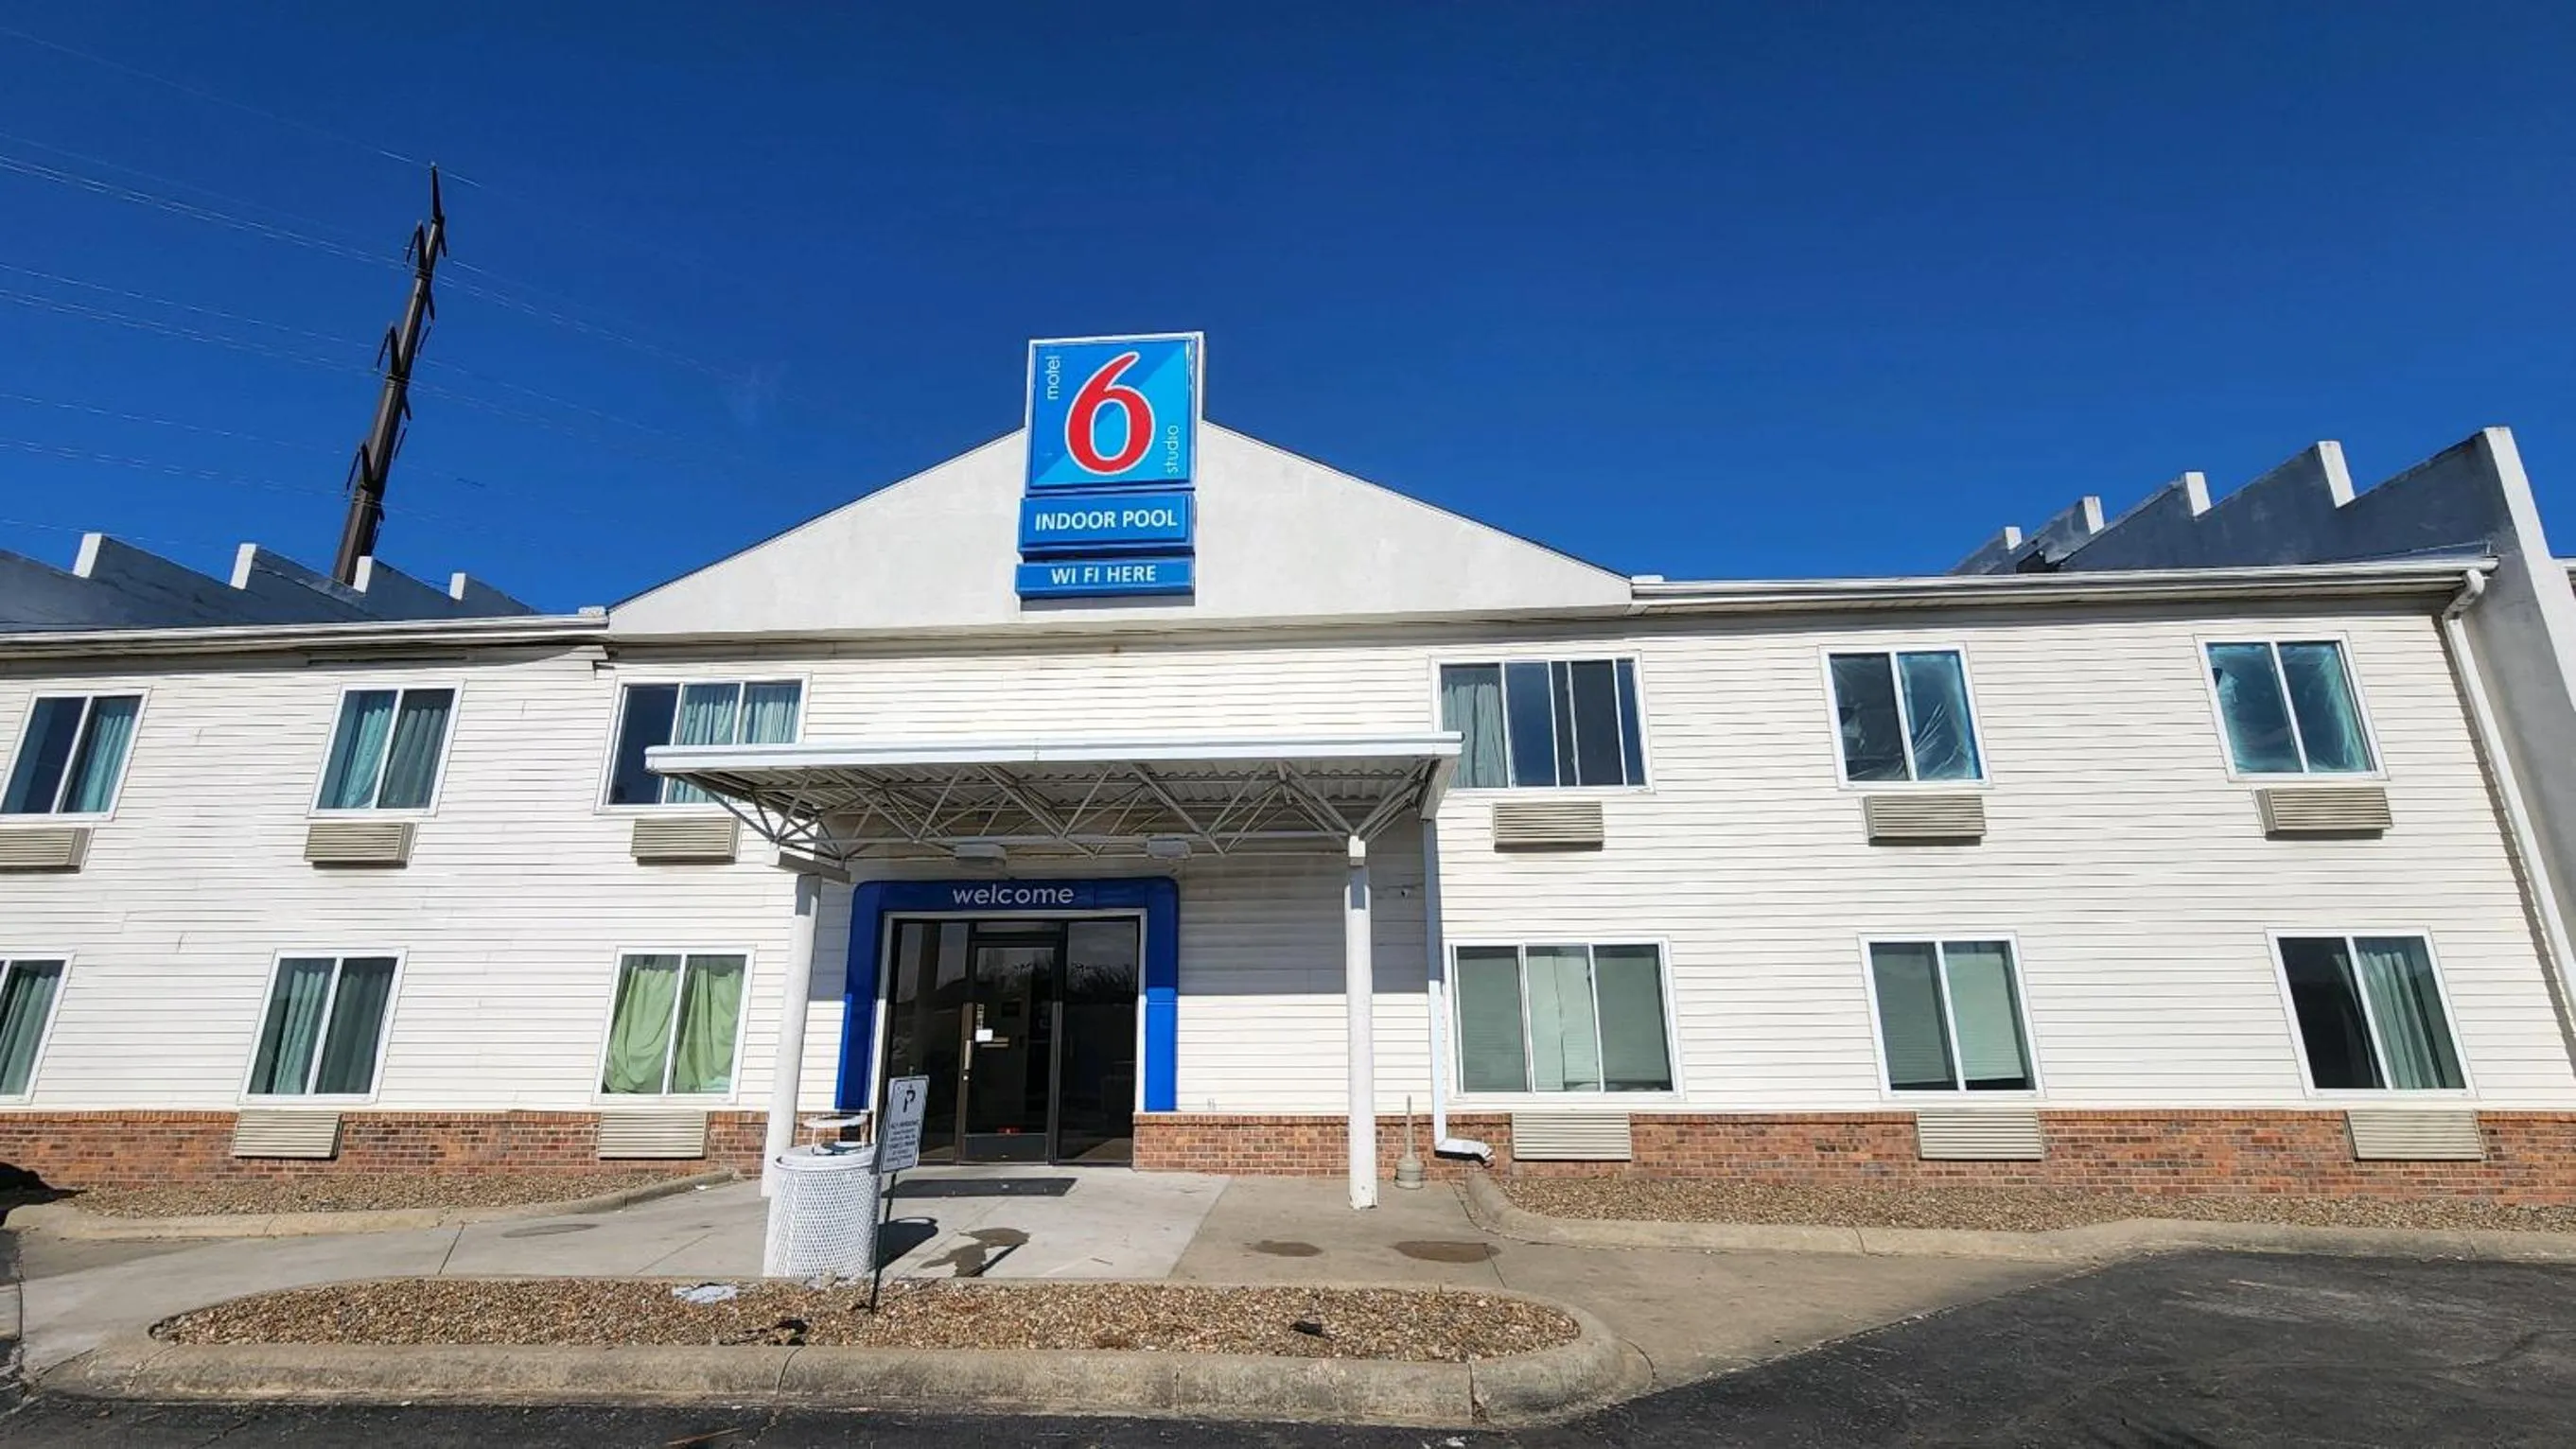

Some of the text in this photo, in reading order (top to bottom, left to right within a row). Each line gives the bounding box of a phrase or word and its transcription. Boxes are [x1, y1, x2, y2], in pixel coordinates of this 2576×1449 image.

[1046, 356, 1060, 400] motel
[1065, 351, 1156, 476] 6
[1164, 425, 1179, 473] studio
[1035, 509, 1178, 532] INDOOR POOL
[1051, 565, 1156, 585] WI FI HERE
[953, 883, 1075, 904] welcome
